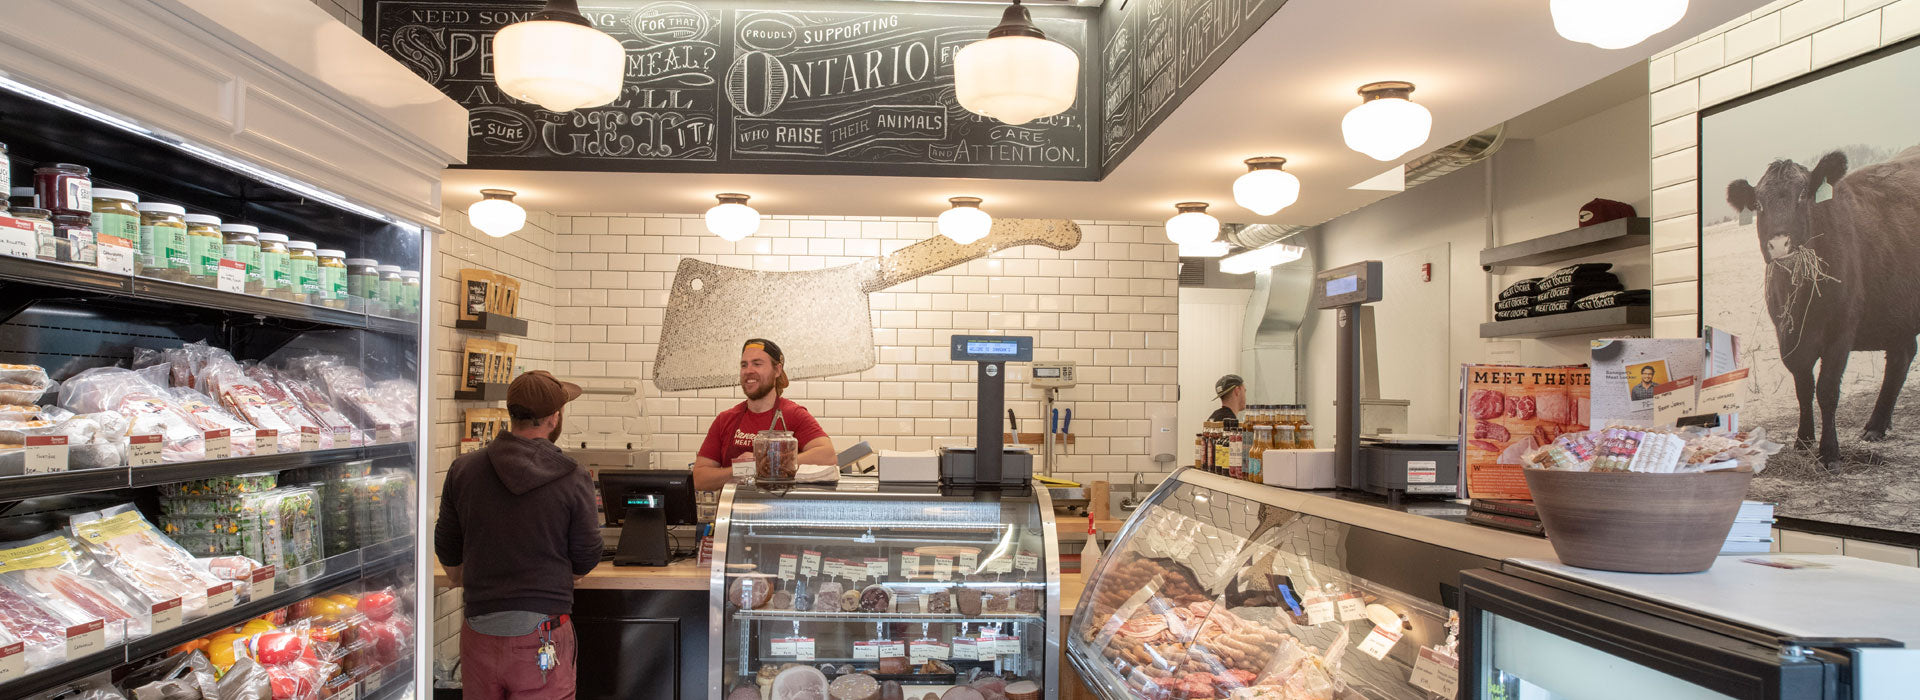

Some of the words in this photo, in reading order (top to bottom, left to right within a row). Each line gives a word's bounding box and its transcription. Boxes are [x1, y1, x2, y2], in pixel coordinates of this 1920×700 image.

[411, 10, 470, 24] NEED
[641, 18, 666, 31] FOR
[668, 18, 696, 27] THAT
[745, 28, 795, 39] PROUDLY
[803, 15, 898, 44] SUPPORTING
[626, 46, 716, 78] MEAL?
[725, 41, 930, 117] ONTARIO
[487, 122, 524, 139] SURE
[677, 122, 716, 149] IT!
[740, 129, 770, 143] WHO
[776, 126, 823, 145] RAISE
[830, 119, 870, 143] THEIR
[876, 115, 942, 131] ANIMALS
[990, 128, 1051, 144] CARE,
[932, 149, 953, 158] AND
[953, 138, 1080, 162] ATTENTION.
[1474, 372, 1525, 384] MEET
[1532, 373, 1566, 385] THE
[1569, 374, 1590, 386] STE
